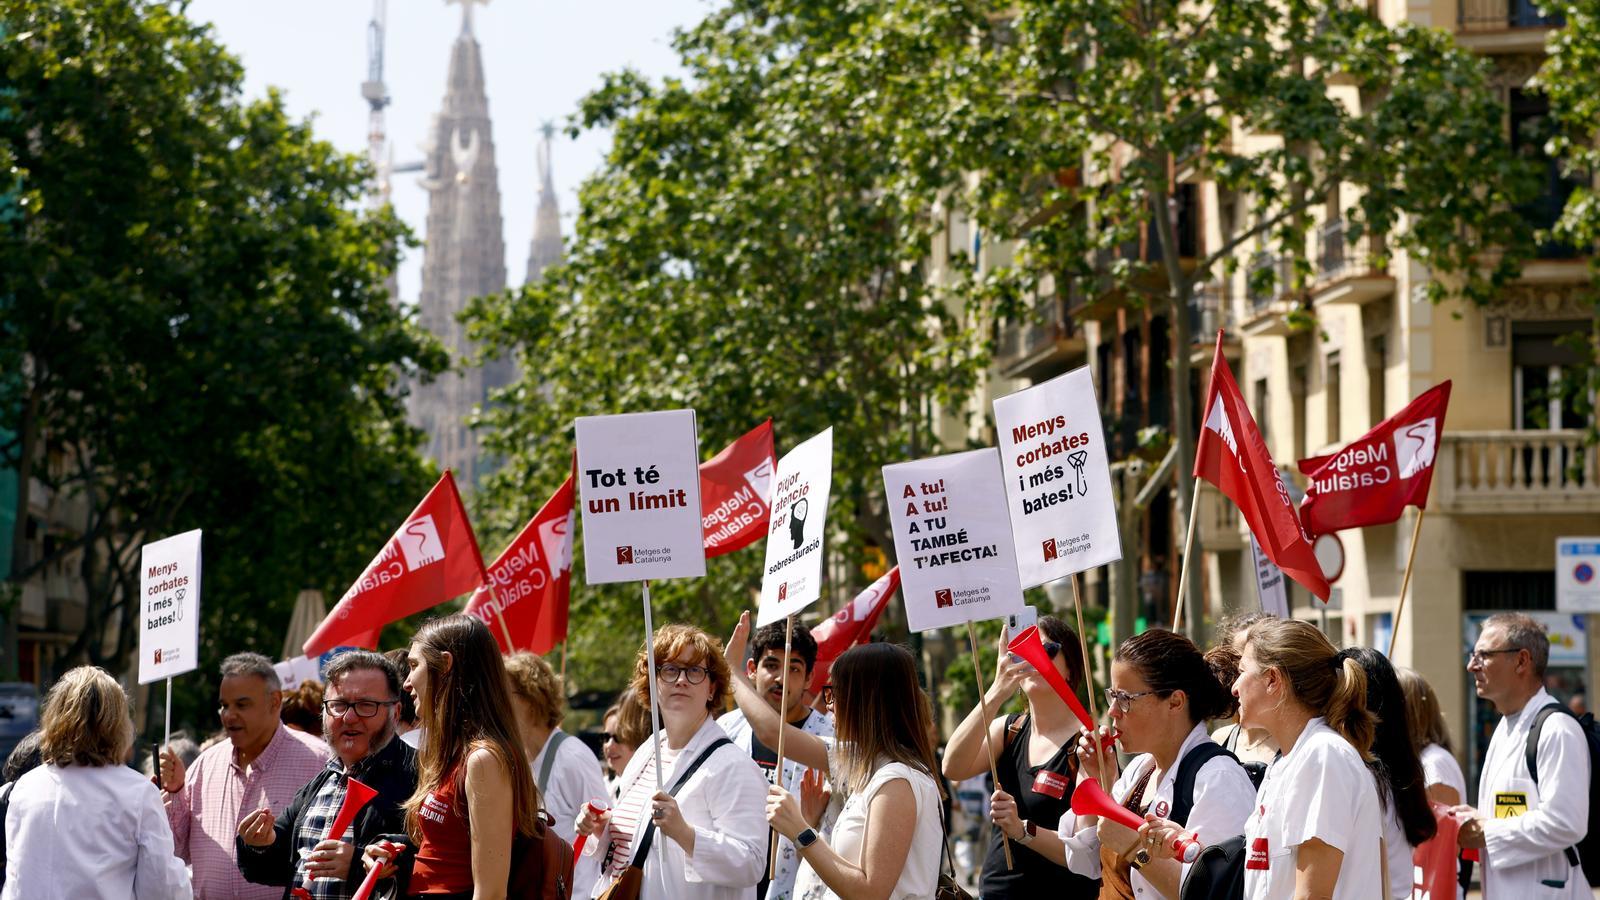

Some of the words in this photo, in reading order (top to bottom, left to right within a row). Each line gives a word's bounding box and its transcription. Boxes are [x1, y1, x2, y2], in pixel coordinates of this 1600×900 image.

[1012, 414, 1066, 444] Menys
[1017, 432, 1089, 467] corbates
[586, 468, 626, 488] Tot
[634, 465, 660, 485] té
[777, 472, 800, 496] Pitjor
[1019, 476, 1025, 491] i
[1029, 465, 1064, 488] més
[775, 482, 809, 514] atenció
[903, 485, 916, 498] A
[920, 479, 945, 495] tu!
[589, 498, 619, 514] un
[629, 489, 687, 511] límit
[906, 502, 919, 516] A
[923, 497, 948, 513] tu!
[1023, 483, 1073, 515] bates!
[772, 514, 787, 534] per
[909, 522, 920, 534] A
[924, 517, 947, 531] TU
[911, 529, 968, 551] TAMBÉ
[1057, 536, 1080, 548] Metges
[1081, 533, 1089, 541] de
[1058, 542, 1091, 557] Catalunya
[634, 548, 660, 557] Metges
[635, 555, 671, 564] Catalunya
[768, 537, 819, 575] sobresaturació
[914, 545, 998, 569] T’AFECTA!
[149, 561, 177, 578] Menys
[148, 575, 188, 595] corbates
[953, 589, 980, 598] Metges
[154, 596, 172, 611] més
[954, 594, 990, 605] Catalunya
[148, 611, 176, 630] bates!
